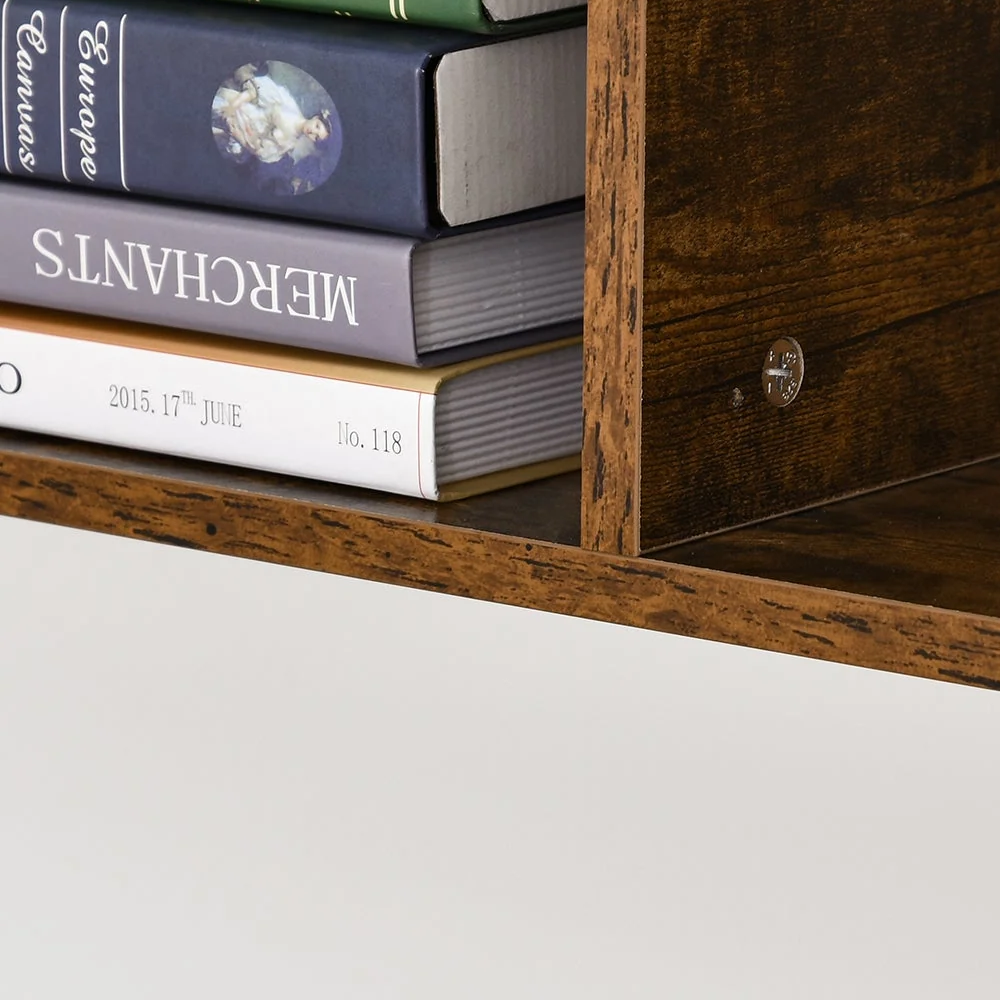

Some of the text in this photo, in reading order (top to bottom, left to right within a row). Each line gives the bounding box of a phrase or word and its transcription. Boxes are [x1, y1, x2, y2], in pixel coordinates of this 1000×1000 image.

[17, 10, 46, 172] Canvas
[70, 20, 109, 181] Europe
[32, 228, 360, 326] MERCHANTS
[109, 384, 155, 413] 2015.
[200, 399, 242, 428] JUNE
[338, 421, 402, 455] No. 118
